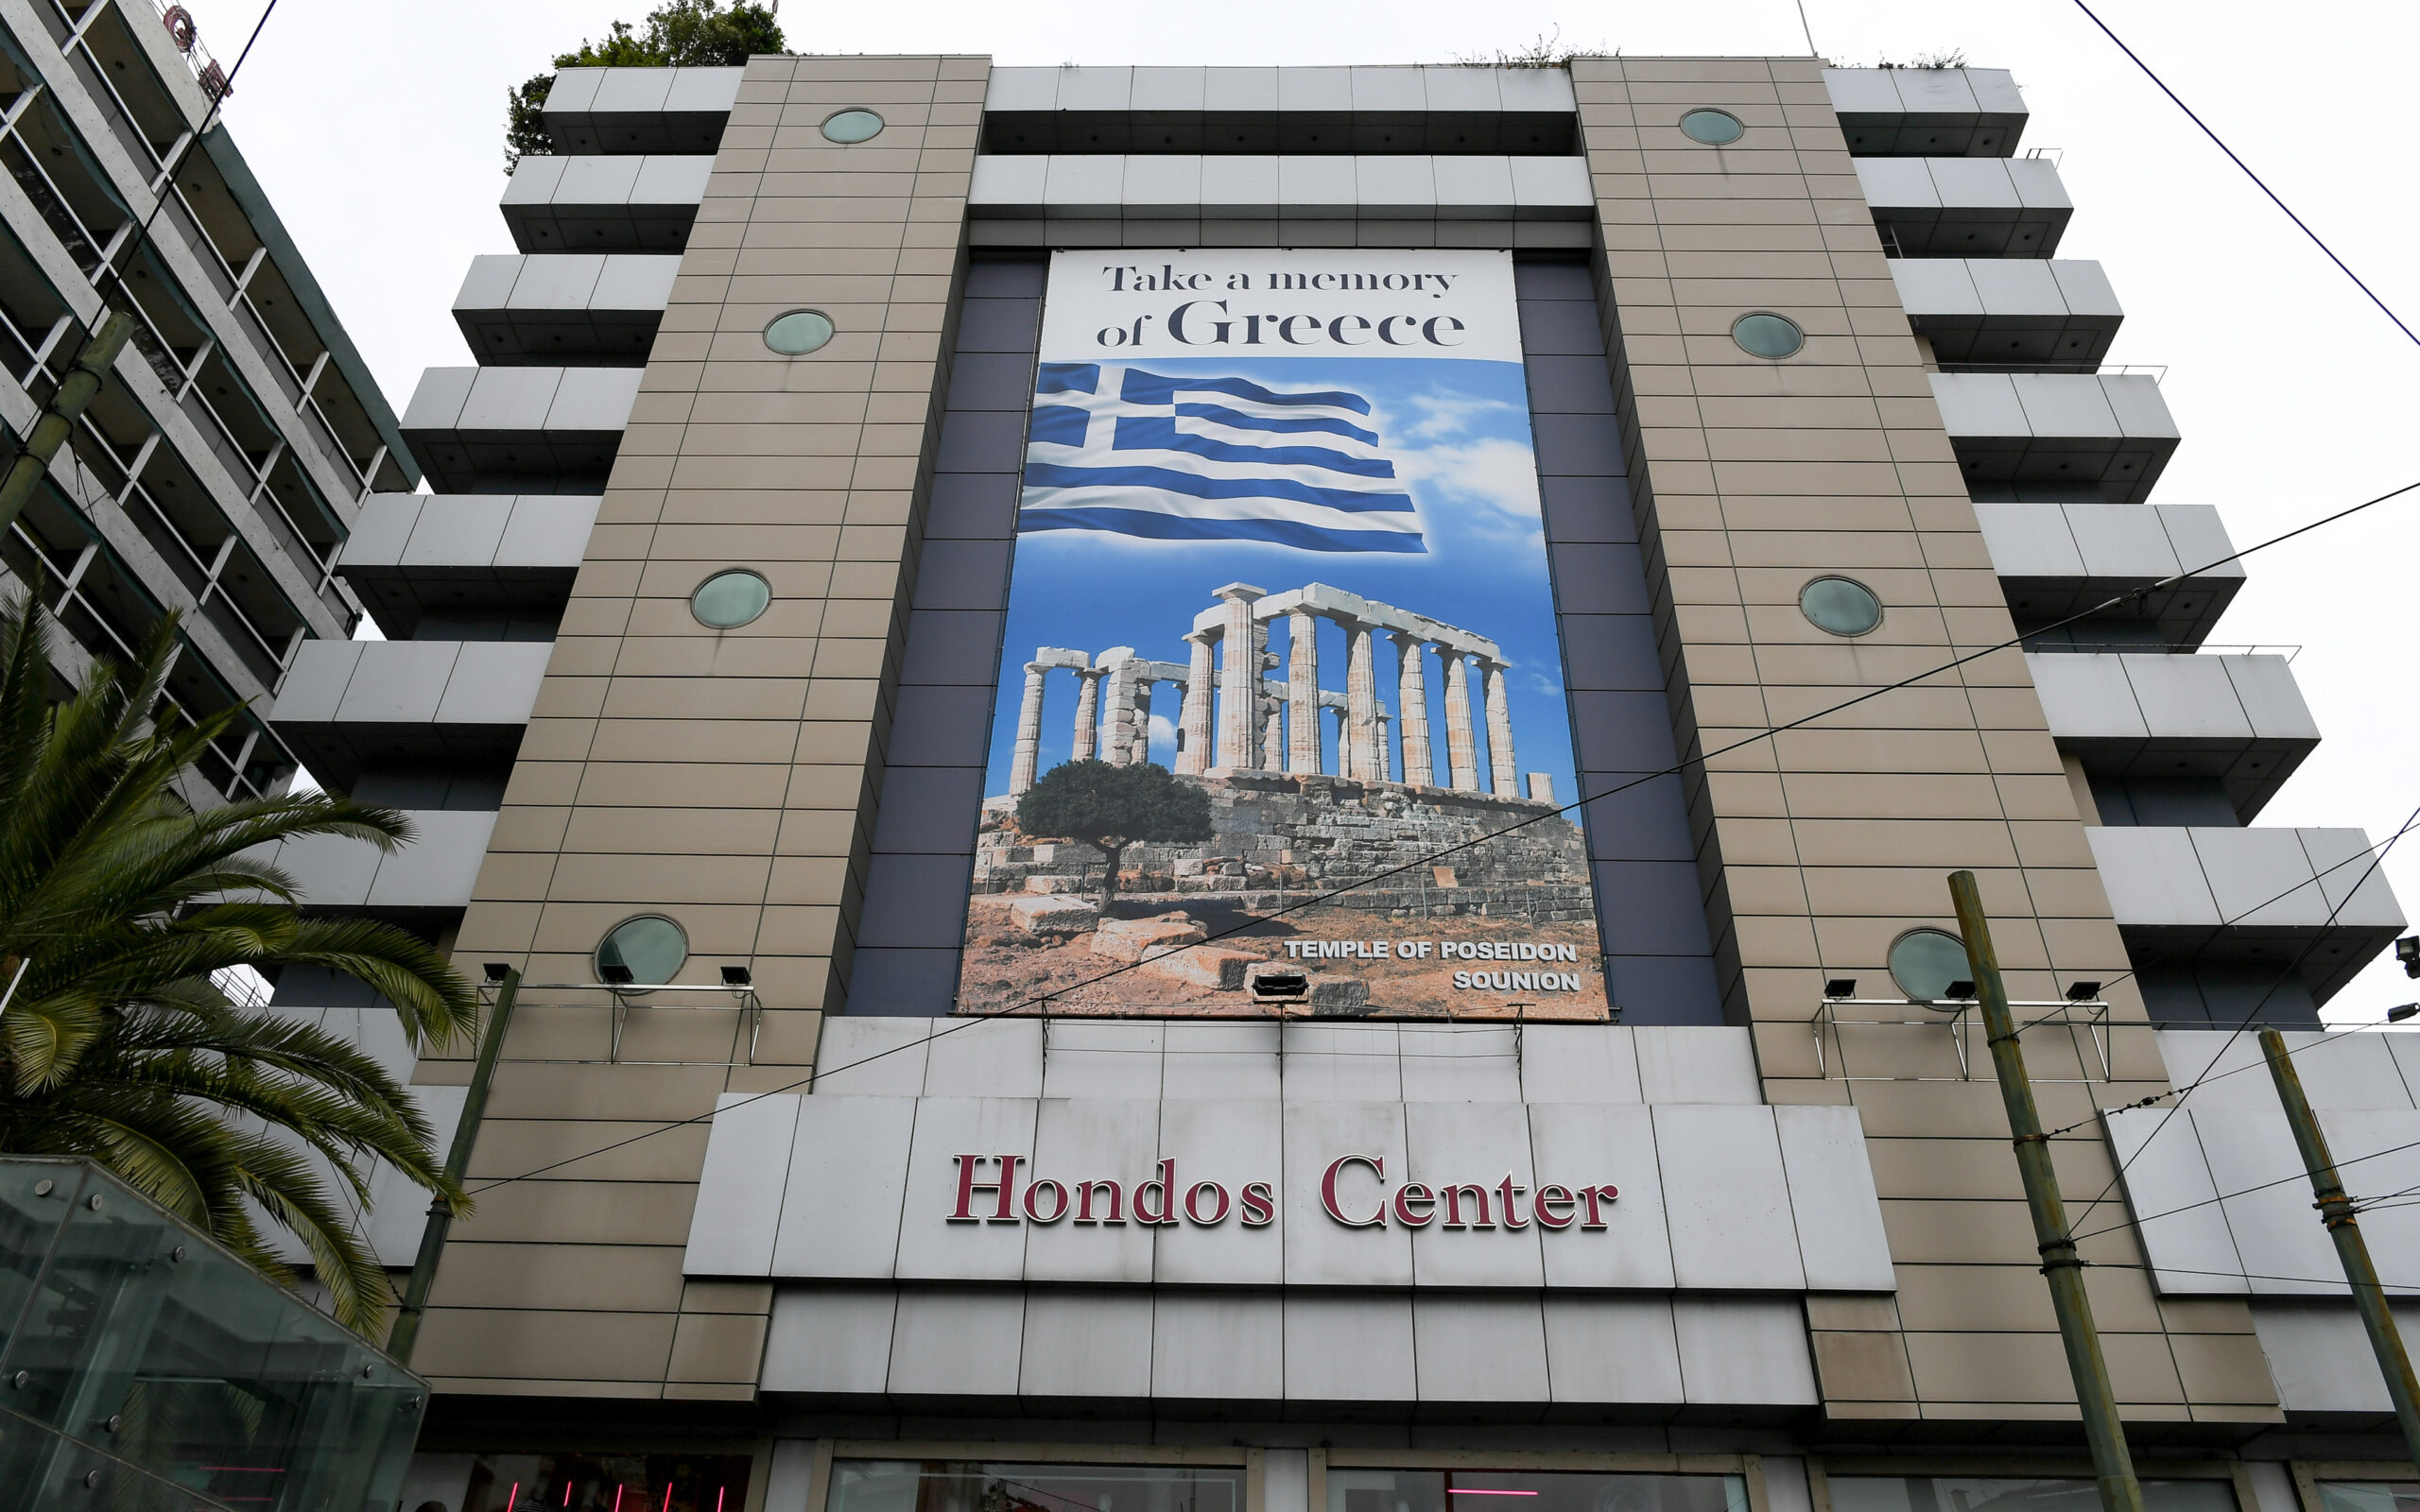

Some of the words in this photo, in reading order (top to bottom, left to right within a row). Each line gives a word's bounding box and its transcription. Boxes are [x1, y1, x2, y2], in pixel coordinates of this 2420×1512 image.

[1102, 265, 1212, 292] Take
[1228, 273, 1250, 291] a
[1270, 272, 1459, 298] memory
[1097, 315, 1152, 347] of
[1167, 300, 1465, 347] Greece
[1284, 940, 1389, 959] TEMPLE
[1397, 940, 1433, 959] OF
[1441, 941, 1577, 962] POSEIDON
[1453, 971, 1581, 991] SOUNION
[945, 1153, 1276, 1226] Hondos
[1319, 1153, 1620, 1230] Center
